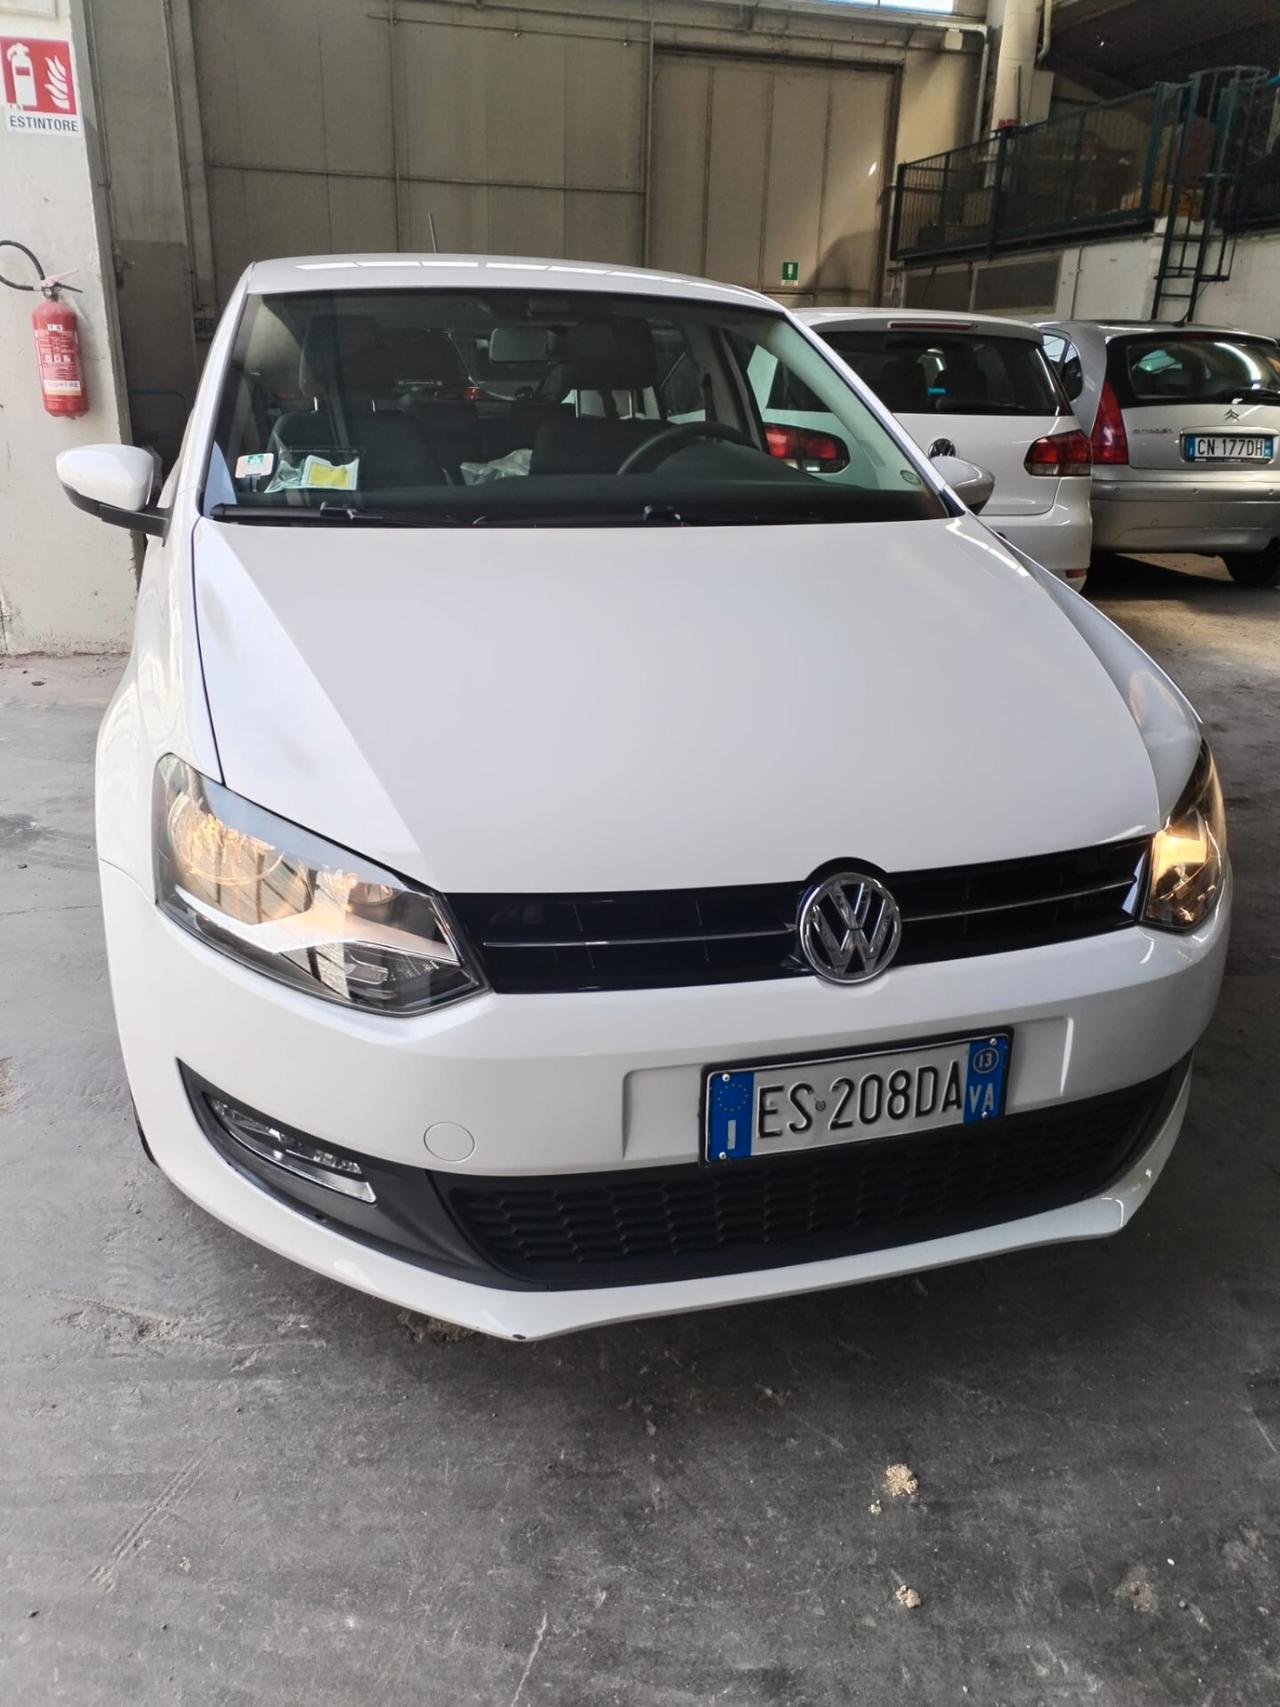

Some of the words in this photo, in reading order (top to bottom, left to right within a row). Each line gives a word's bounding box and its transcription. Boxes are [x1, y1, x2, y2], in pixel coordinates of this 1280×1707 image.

[9, 115, 79, 132] ESTINTORE
[1197, 439, 1216, 456] CN
[1222, 439, 1263, 457] 177DH
[978, 1054, 993, 1068] 13
[756, 1082, 815, 1139] ES
[828, 1059, 964, 1131] 208DA
[969, 1081, 995, 1114] VA
